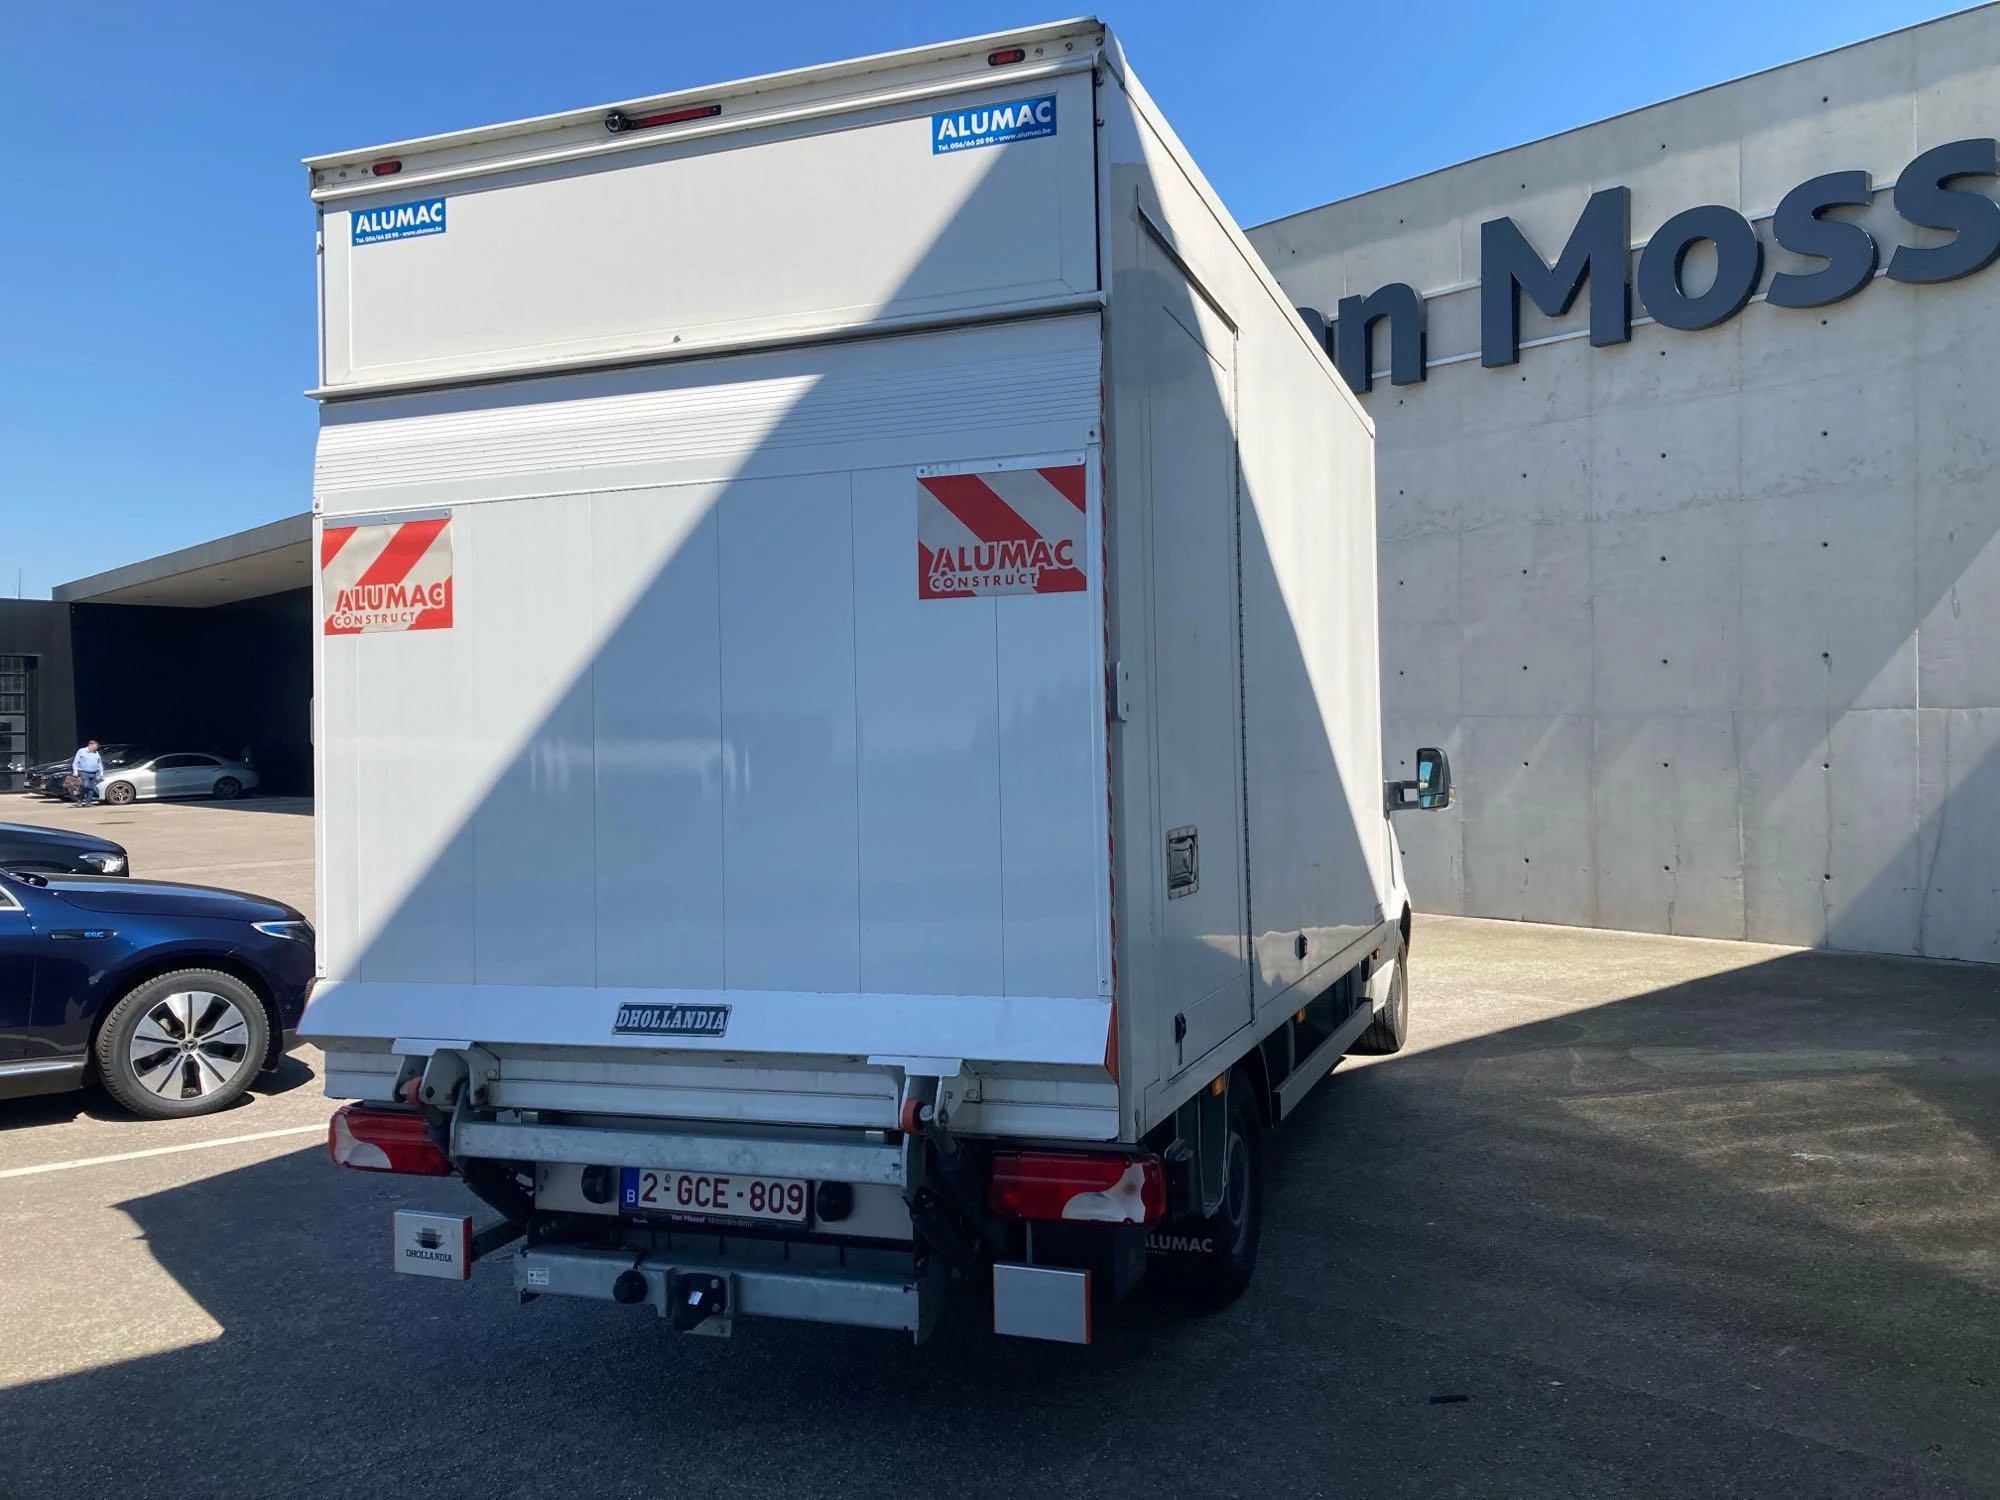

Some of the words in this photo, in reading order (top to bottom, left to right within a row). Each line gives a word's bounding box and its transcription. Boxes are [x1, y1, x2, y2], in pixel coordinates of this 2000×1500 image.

[938, 101, 1051, 140] ALUMAC
[950, 140, 975, 149] 056/66
[999, 128, 1051, 142] www.alumac.be
[356, 202, 442, 234] ALUMAC
[1481, 138, 2000, 369] Moss
[933, 539, 1073, 573] ALUMAC
[932, 573, 1038, 589] CONSTRUCT
[335, 582, 443, 612] ALUMAC
[335, 612, 415, 626] CONSTRUCT
[615, 1009, 725, 1030] DHOLLANDIA
[626, 1189, 636, 1203] B
[406, 1249, 453, 1262] DHOLLANDIA
